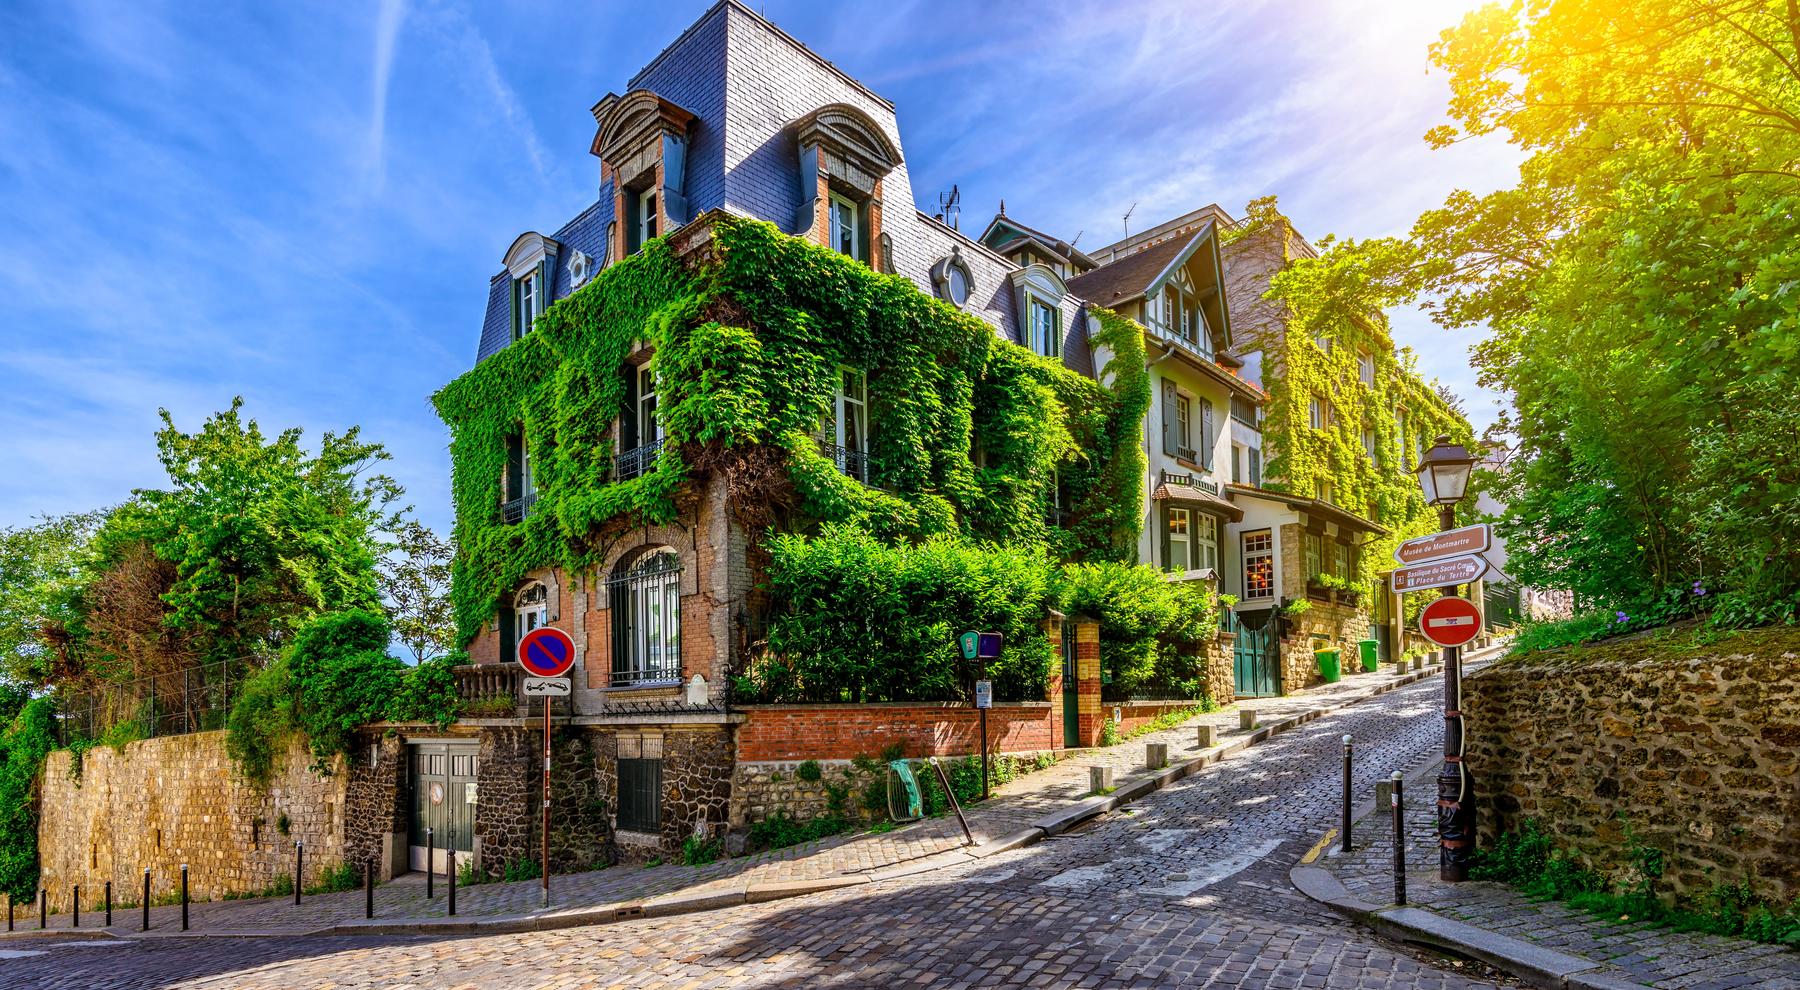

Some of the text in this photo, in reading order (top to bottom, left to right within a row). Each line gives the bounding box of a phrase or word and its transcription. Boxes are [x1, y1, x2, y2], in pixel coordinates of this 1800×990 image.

[1403, 548, 1423, 556] Musée
[1433, 538, 1470, 551] Montmartre
[1407, 570, 1431, 578] Basilique
[1440, 564, 1456, 573] Sacré
[1416, 577, 1434, 585] Place
